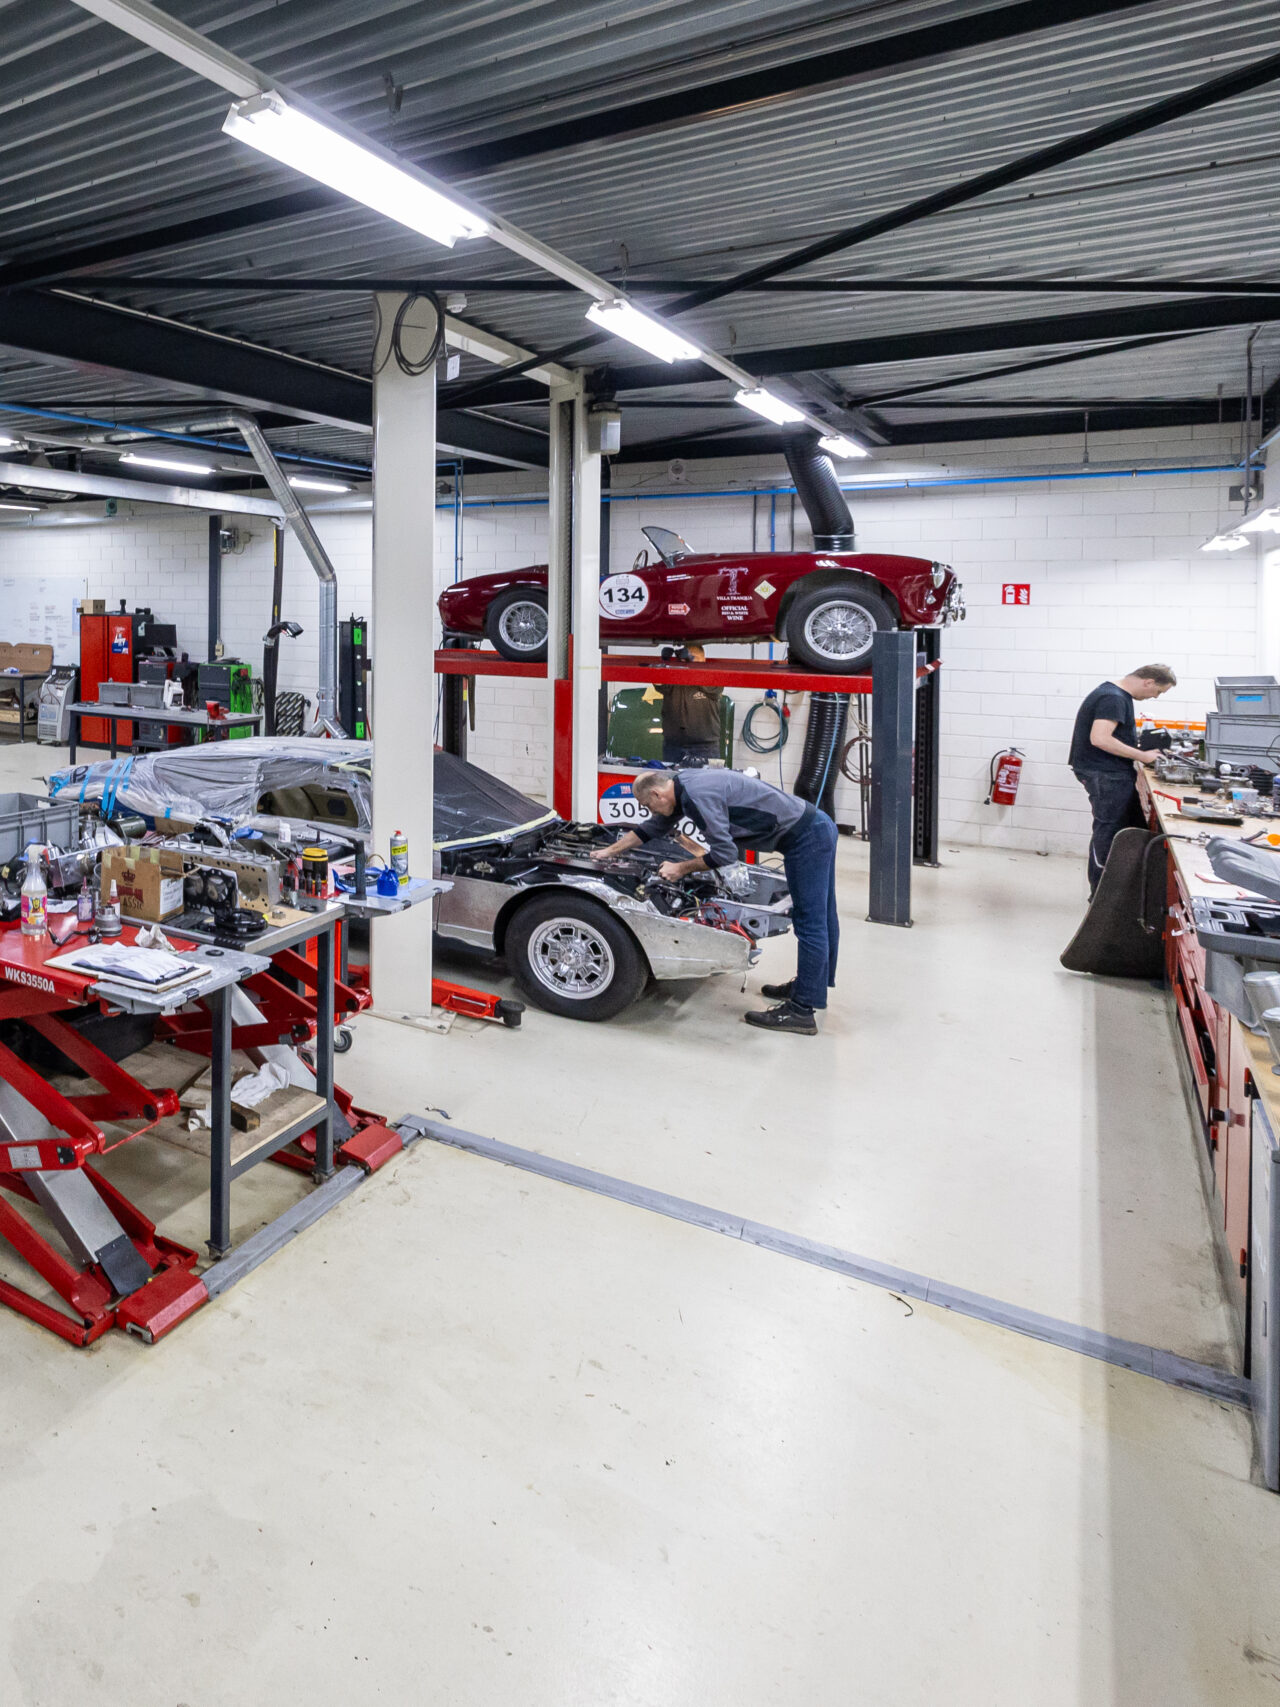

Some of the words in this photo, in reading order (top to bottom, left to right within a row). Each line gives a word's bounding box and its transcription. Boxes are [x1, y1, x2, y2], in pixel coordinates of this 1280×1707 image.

[603, 586, 645, 603] 134
[609, 802, 650, 818] 305
[4, 966, 55, 993] WKS3550A
